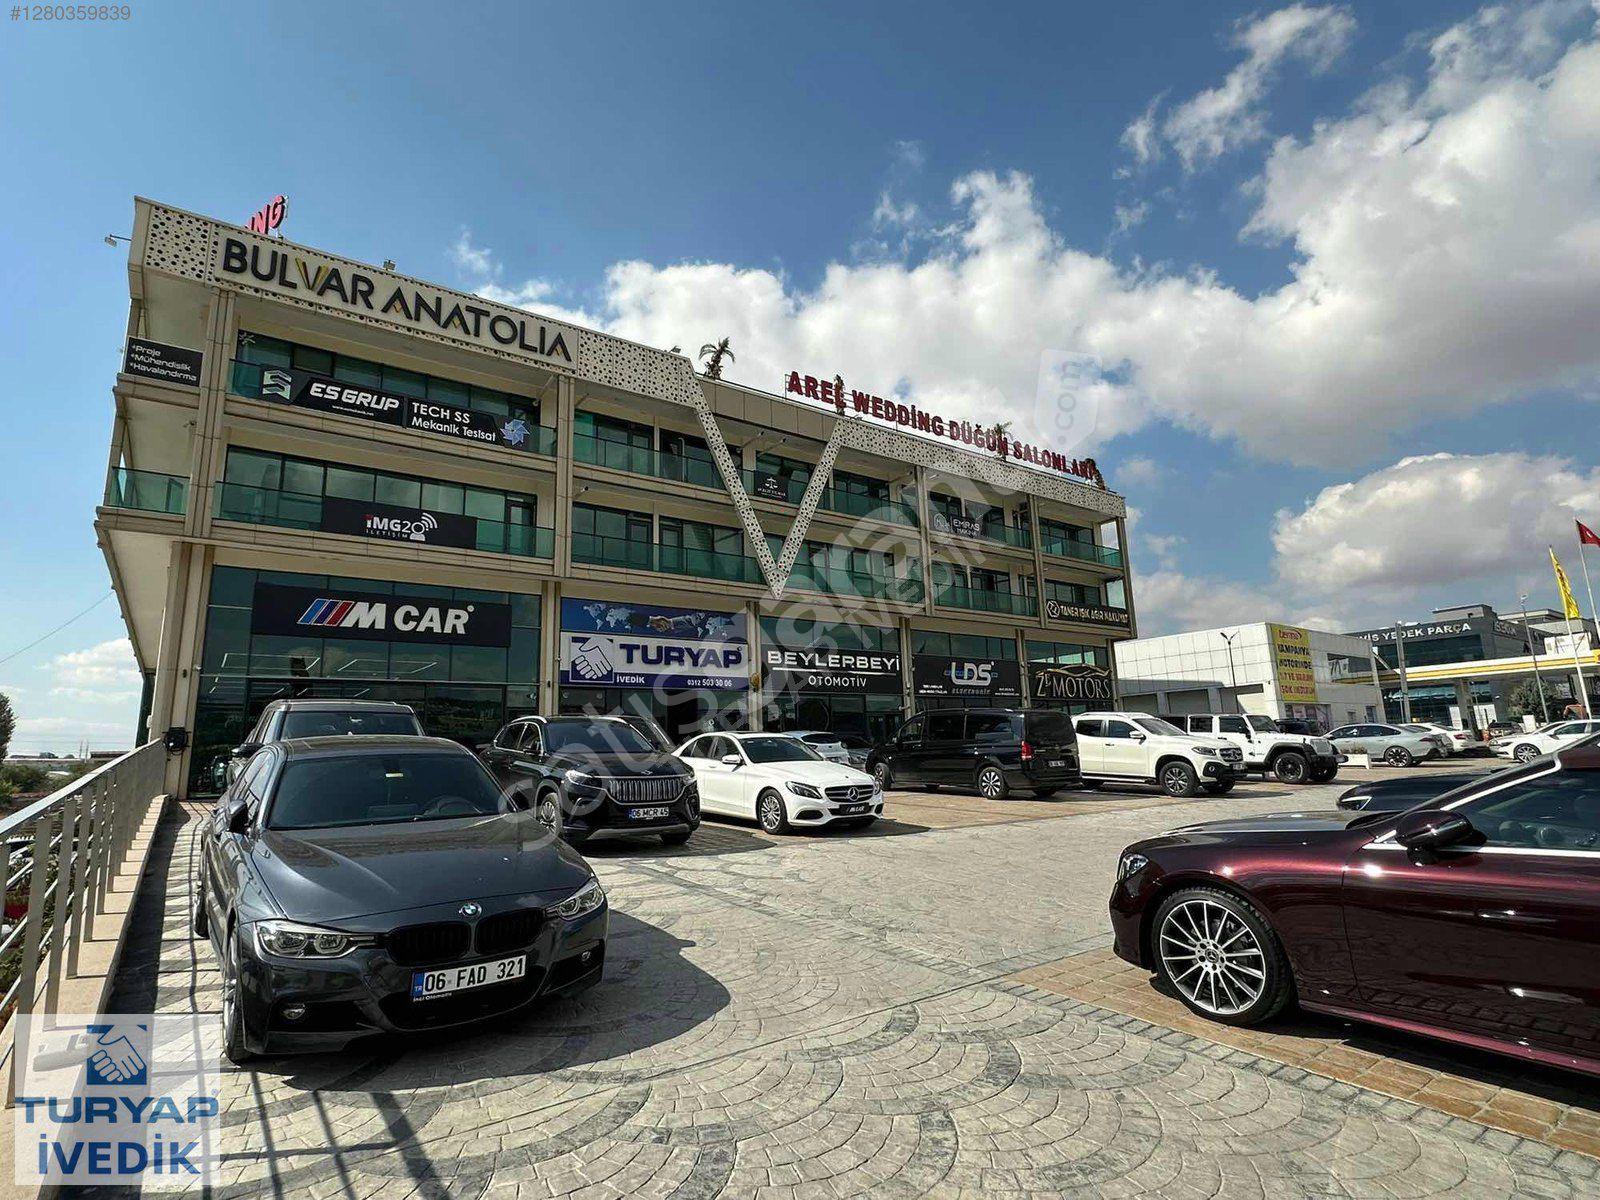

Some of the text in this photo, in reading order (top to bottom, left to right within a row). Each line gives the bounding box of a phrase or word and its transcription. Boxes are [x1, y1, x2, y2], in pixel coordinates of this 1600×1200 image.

[222, 238, 573, 362] BULVAR ANATOLIA
[341, 389, 400, 411] GRUP
[412, 402, 470, 424] TECH SS
[852, 389, 944, 436] WEDDİNG
[394, 605, 469, 635] CAR
[1427, 623, 1471, 635] PARÇA
[619, 643, 743, 669] TURYAP
[767, 650, 900, 671] BEYLERBEYİ
[616, 674, 646, 684] İVEDİK
[808, 675, 867, 687] OTOMOTİV
[1052, 675, 1111, 699] MOTORS
[425, 958, 523, 992] 06 FAD 321
